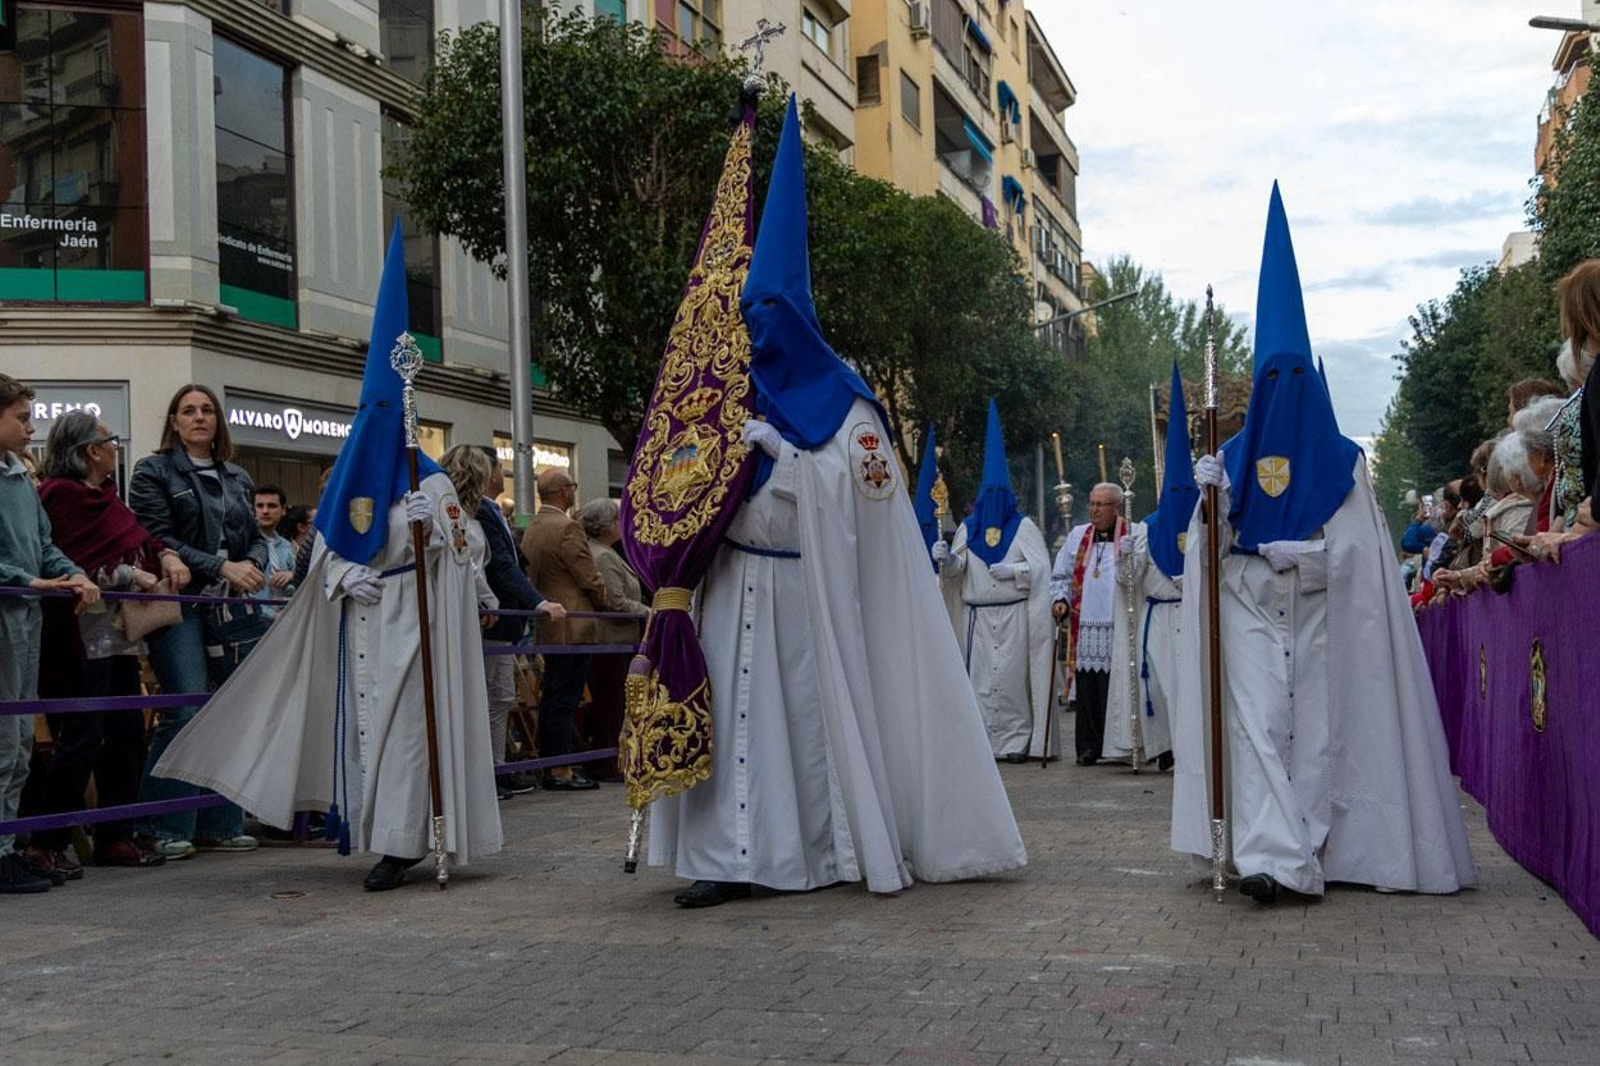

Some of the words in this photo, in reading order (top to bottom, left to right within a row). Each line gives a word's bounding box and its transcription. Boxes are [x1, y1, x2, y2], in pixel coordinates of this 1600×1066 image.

[0, 213, 97, 232] Enfermería
[60, 233, 98, 248] Jaén
[218, 234, 247, 251] indicato
[247, 242, 257, 253] de
[34, 402, 101, 419] RENO
[229, 408, 283, 430] ALVARO
